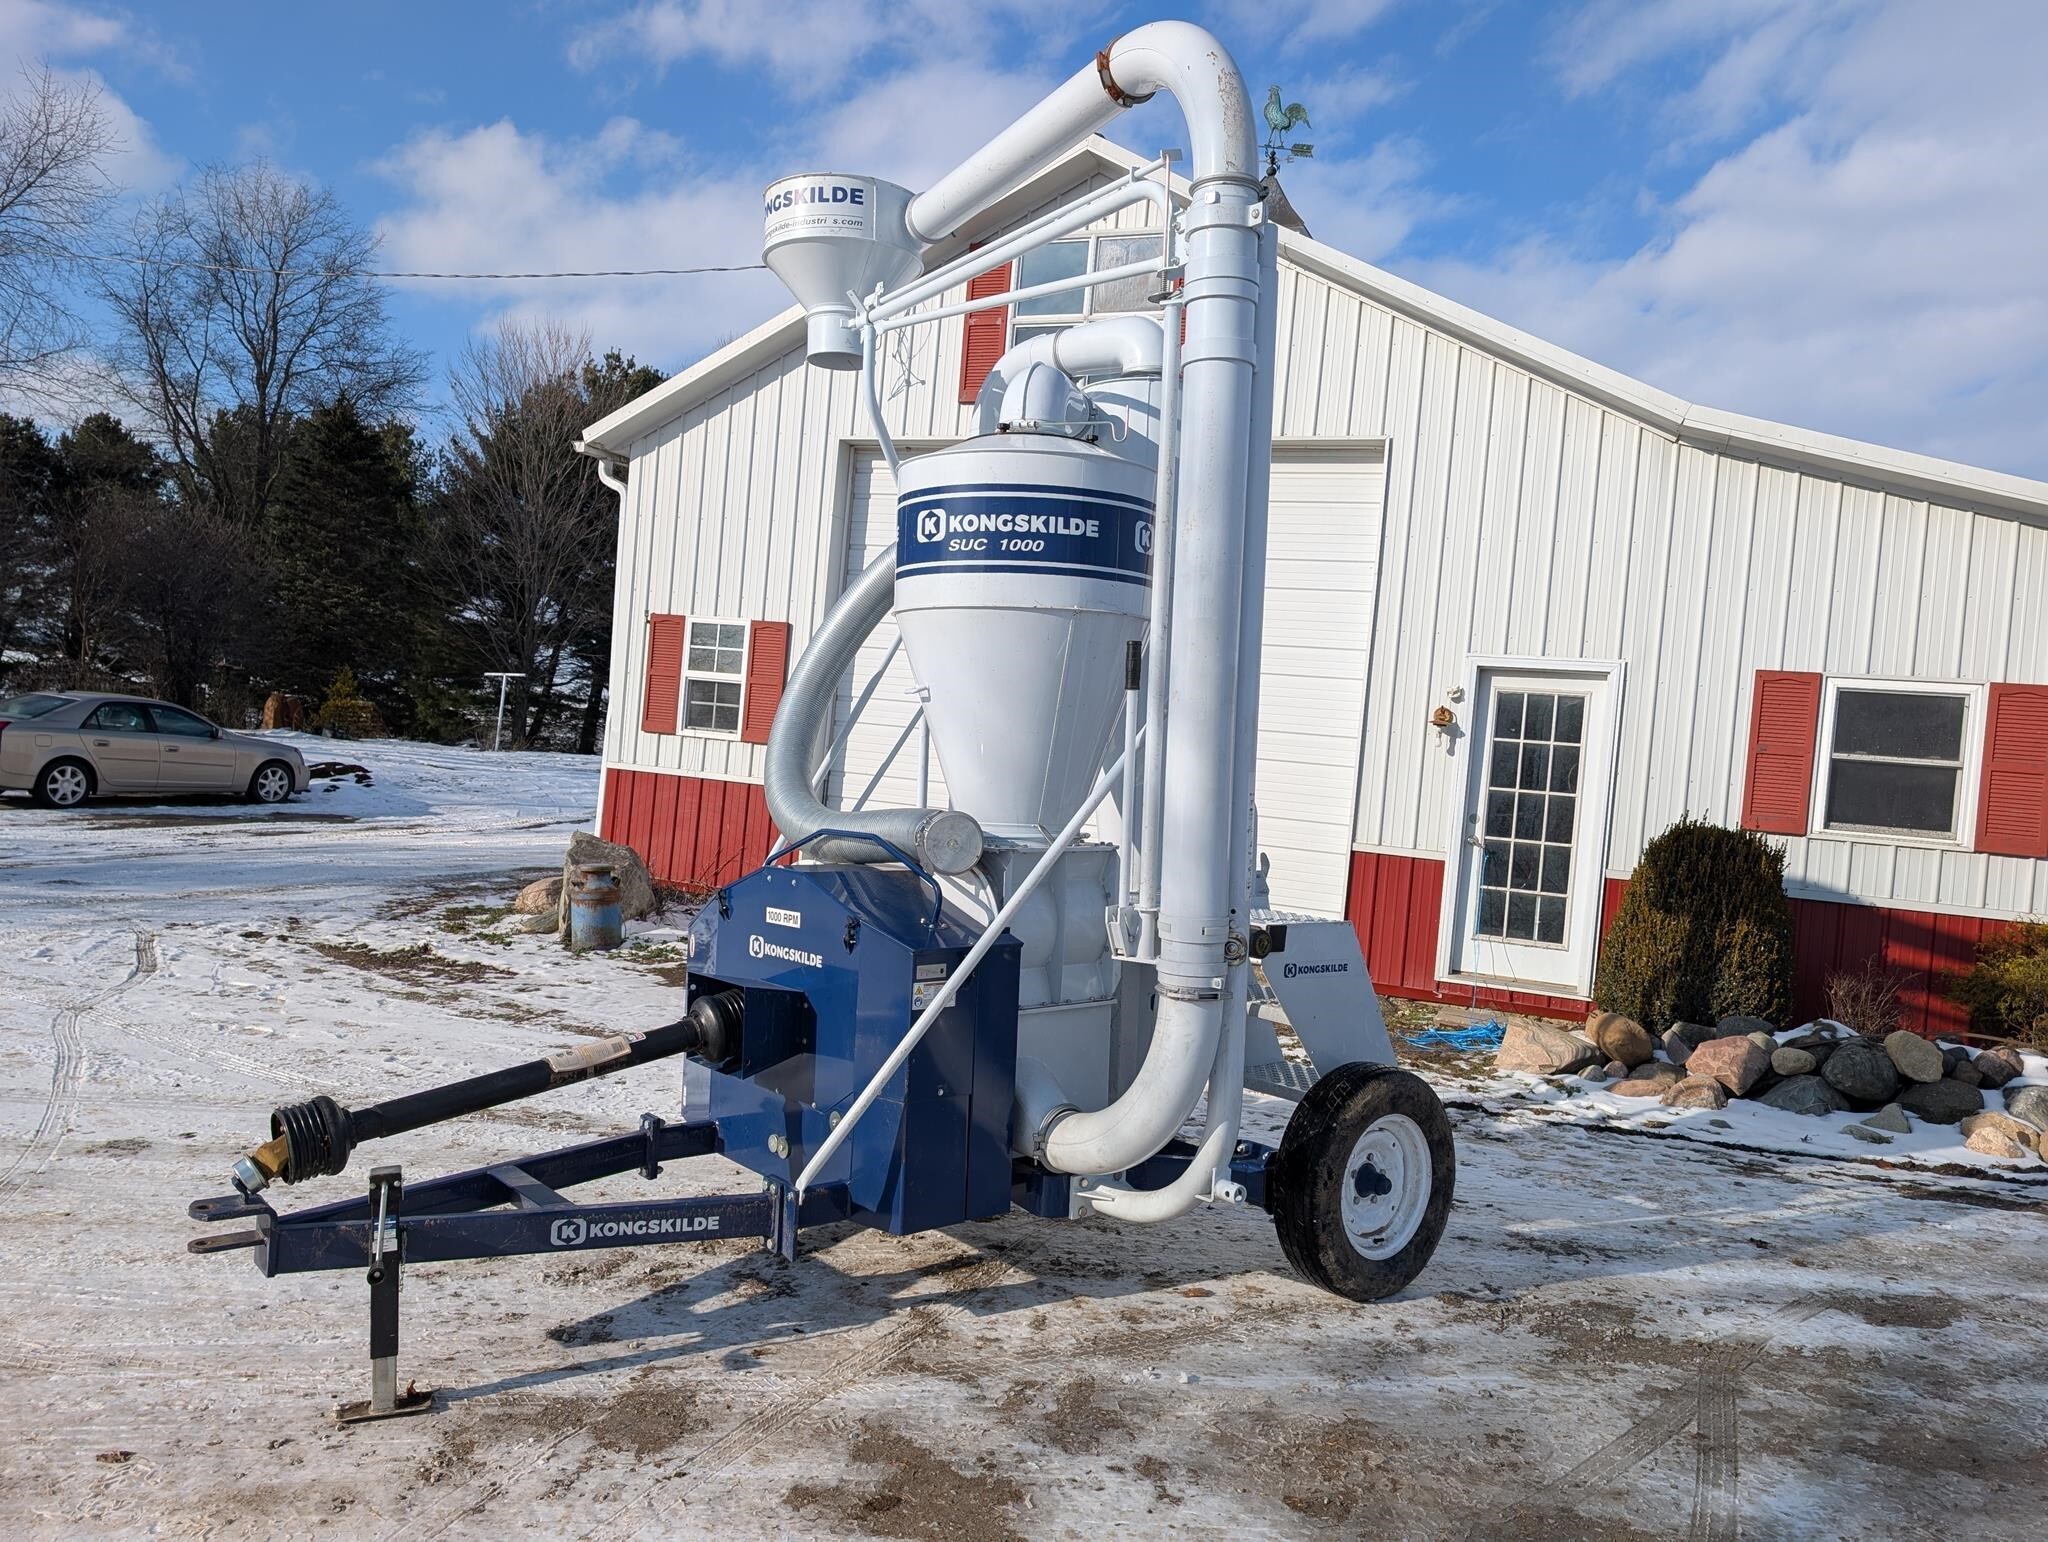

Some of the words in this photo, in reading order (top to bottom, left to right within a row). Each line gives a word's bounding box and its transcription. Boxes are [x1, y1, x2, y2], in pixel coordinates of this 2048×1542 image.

[764, 186, 864, 222] NGSKILDE
[949, 513, 1100, 538] KONGSKILDE
[949, 538, 988, 551] SUC
[1000, 538, 1045, 552] 1000
[767, 910, 782, 923] 1000
[783, 913, 799, 925] RPM
[764, 942, 823, 968] KONGSKILDE
[1297, 963, 1349, 975] KONGSKILDE
[589, 1216, 720, 1238] KONGSKILDE
